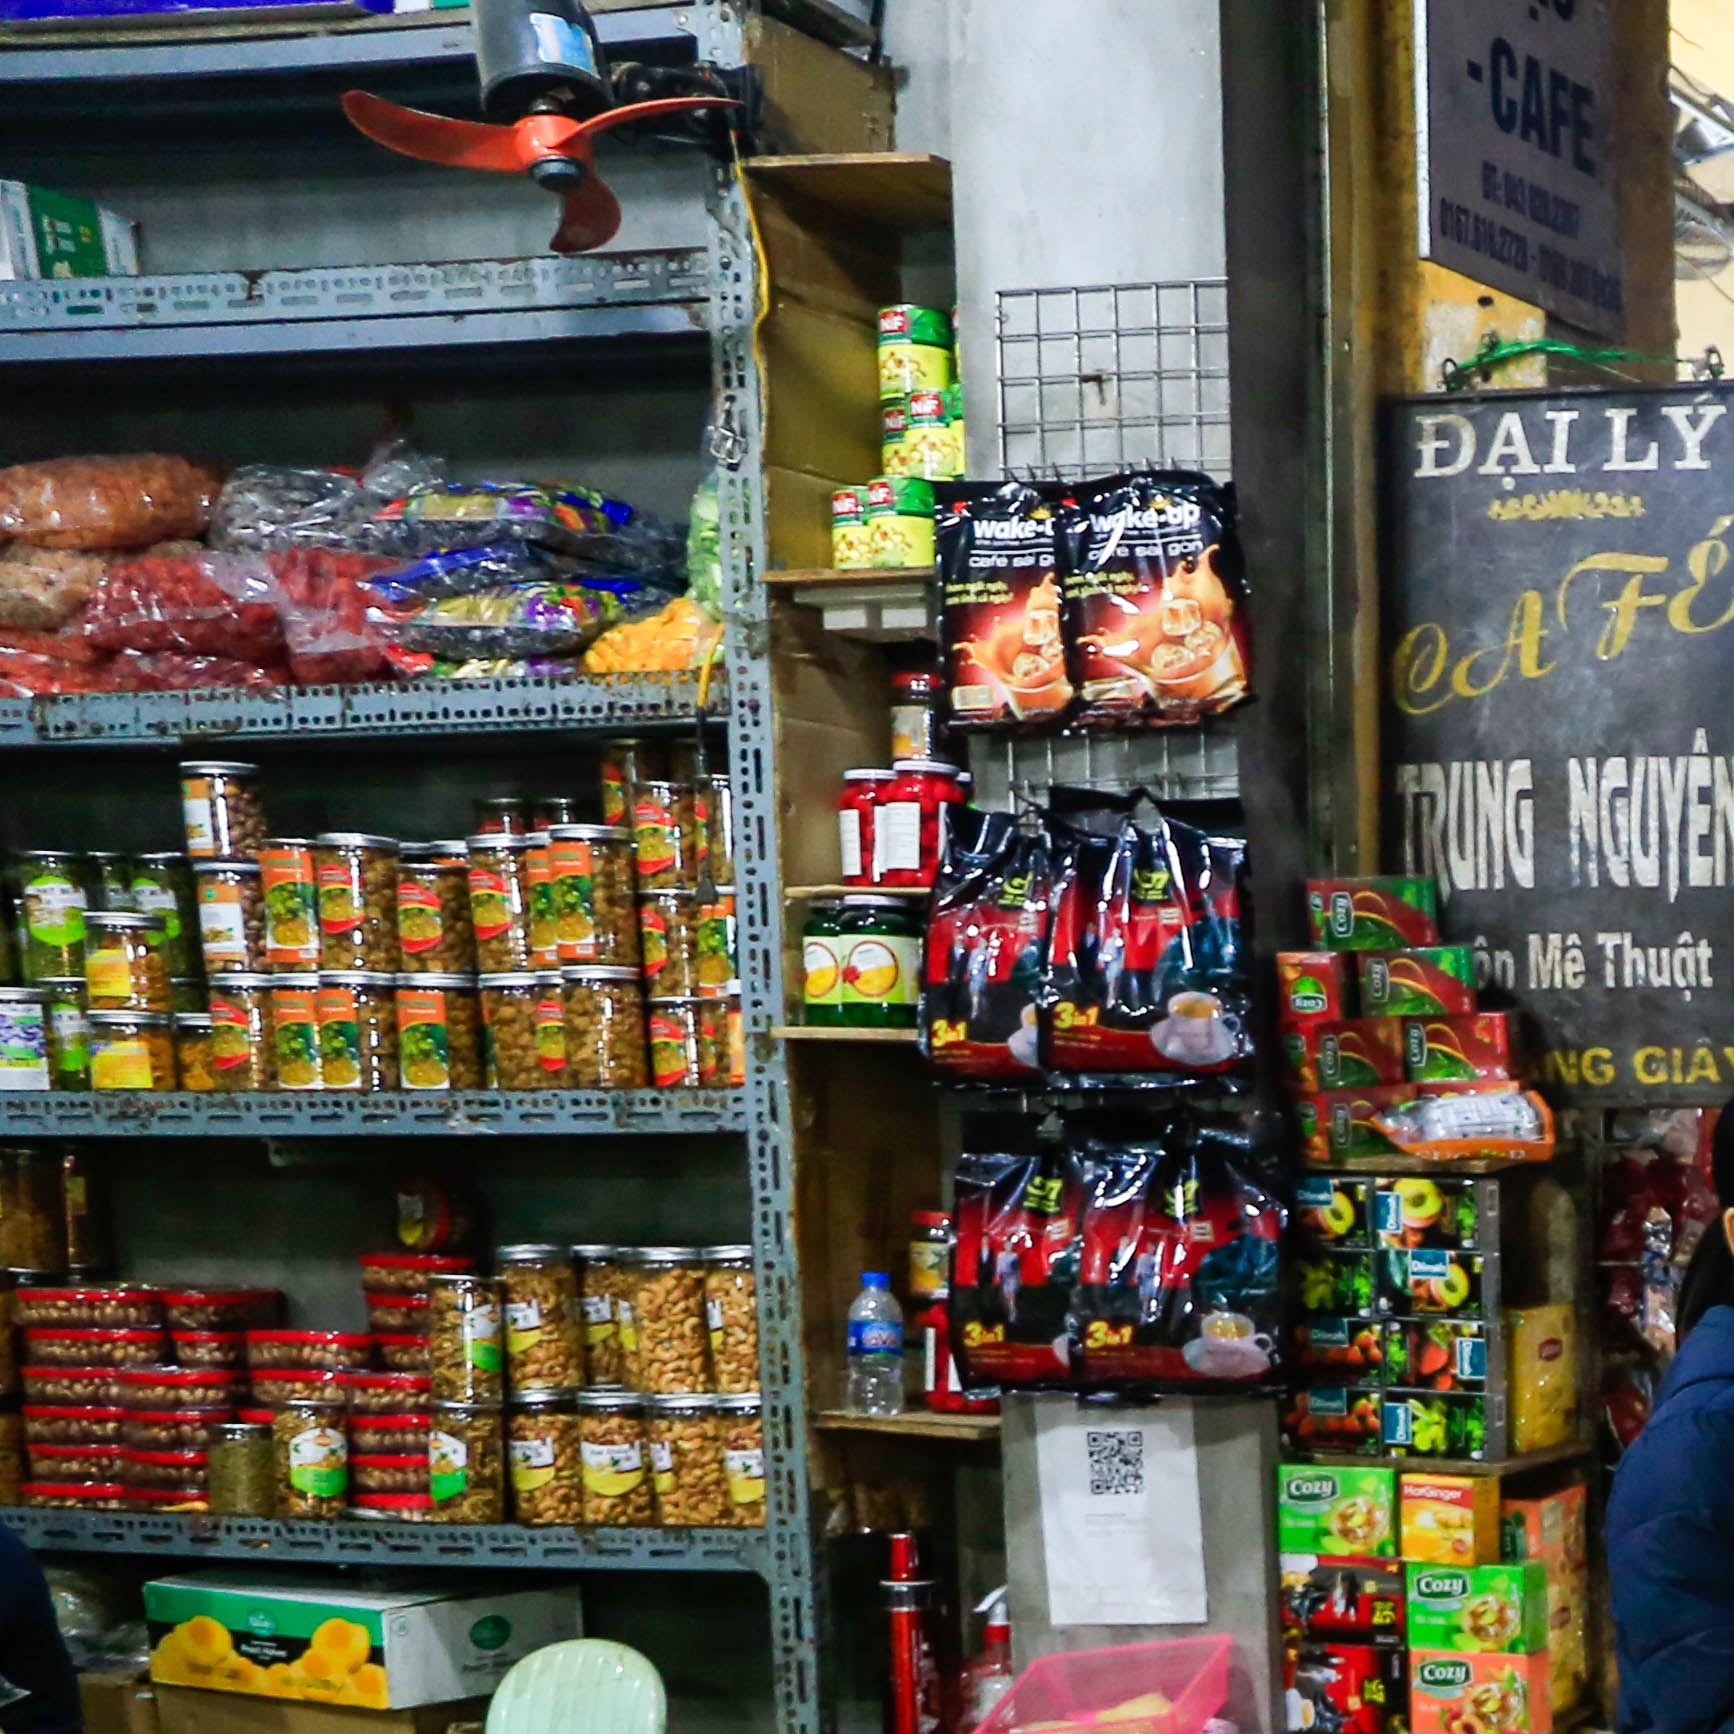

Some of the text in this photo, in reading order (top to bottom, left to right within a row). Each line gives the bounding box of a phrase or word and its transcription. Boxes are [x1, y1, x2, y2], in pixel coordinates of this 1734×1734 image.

[1413, 392, 1728, 491] ĐẠI LÝ
[973, 519, 1055, 541] wake-
[1396, 759, 1536, 905] TRUNG
[1473, 936, 1517, 990] ôn
[1527, 933, 1586, 991] Mê
[1596, 931, 1714, 1002] Thuật
[1545, 1046, 1615, 1086] NG
[1288, 1479, 1333, 1498] Cozy
[1418, 1578, 1464, 1596] Cozy
[1421, 1664, 1467, 1684] Cozy
